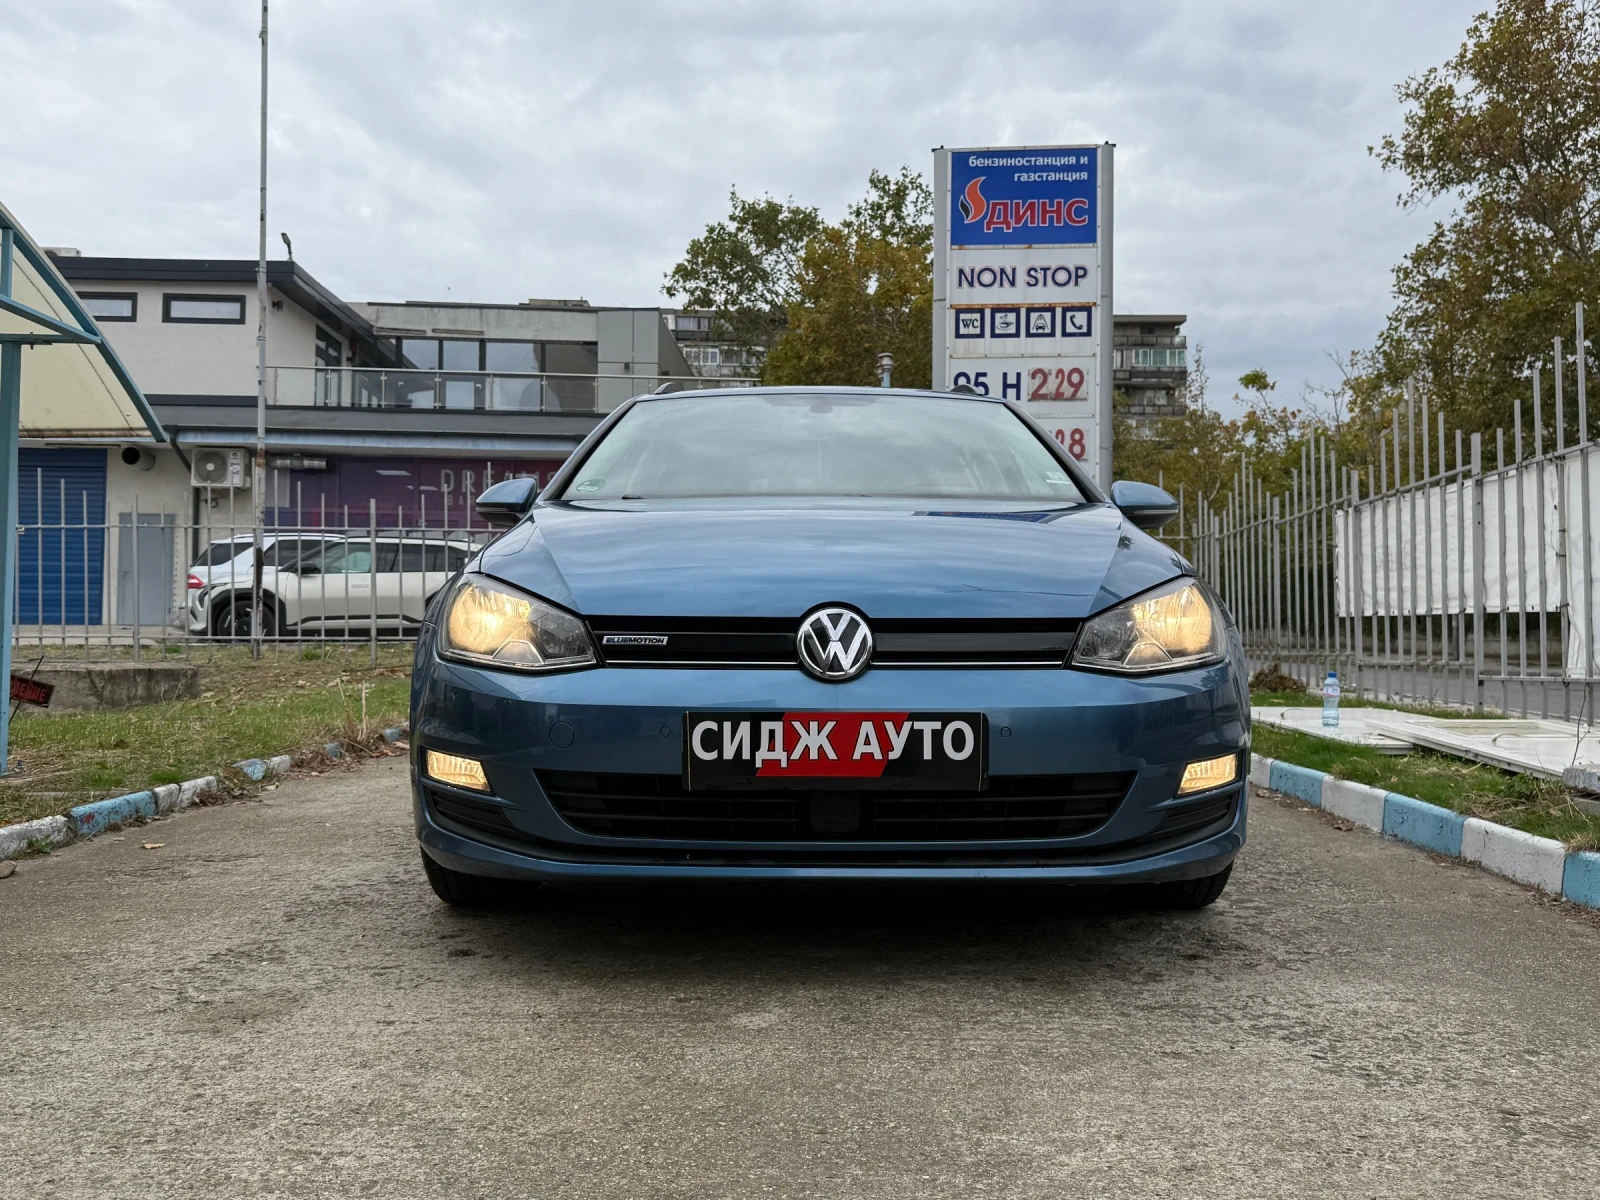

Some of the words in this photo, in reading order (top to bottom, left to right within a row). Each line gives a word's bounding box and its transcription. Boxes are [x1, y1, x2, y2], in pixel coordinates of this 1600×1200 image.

[968, 155, 1076, 168] бензиностанция
[1080, 156, 1088, 165] и
[1014, 171, 1088, 183] газстанция
[984, 198, 1089, 233] ДИНС
[957, 266, 1017, 289] NON
[1025, 265, 1088, 288] STOP
[961, 318, 979, 330] WC
[605, 636, 665, 644] BLUEMOTION
[691, 720, 840, 768] СИДЖ
[851, 720, 975, 761] АУТО
